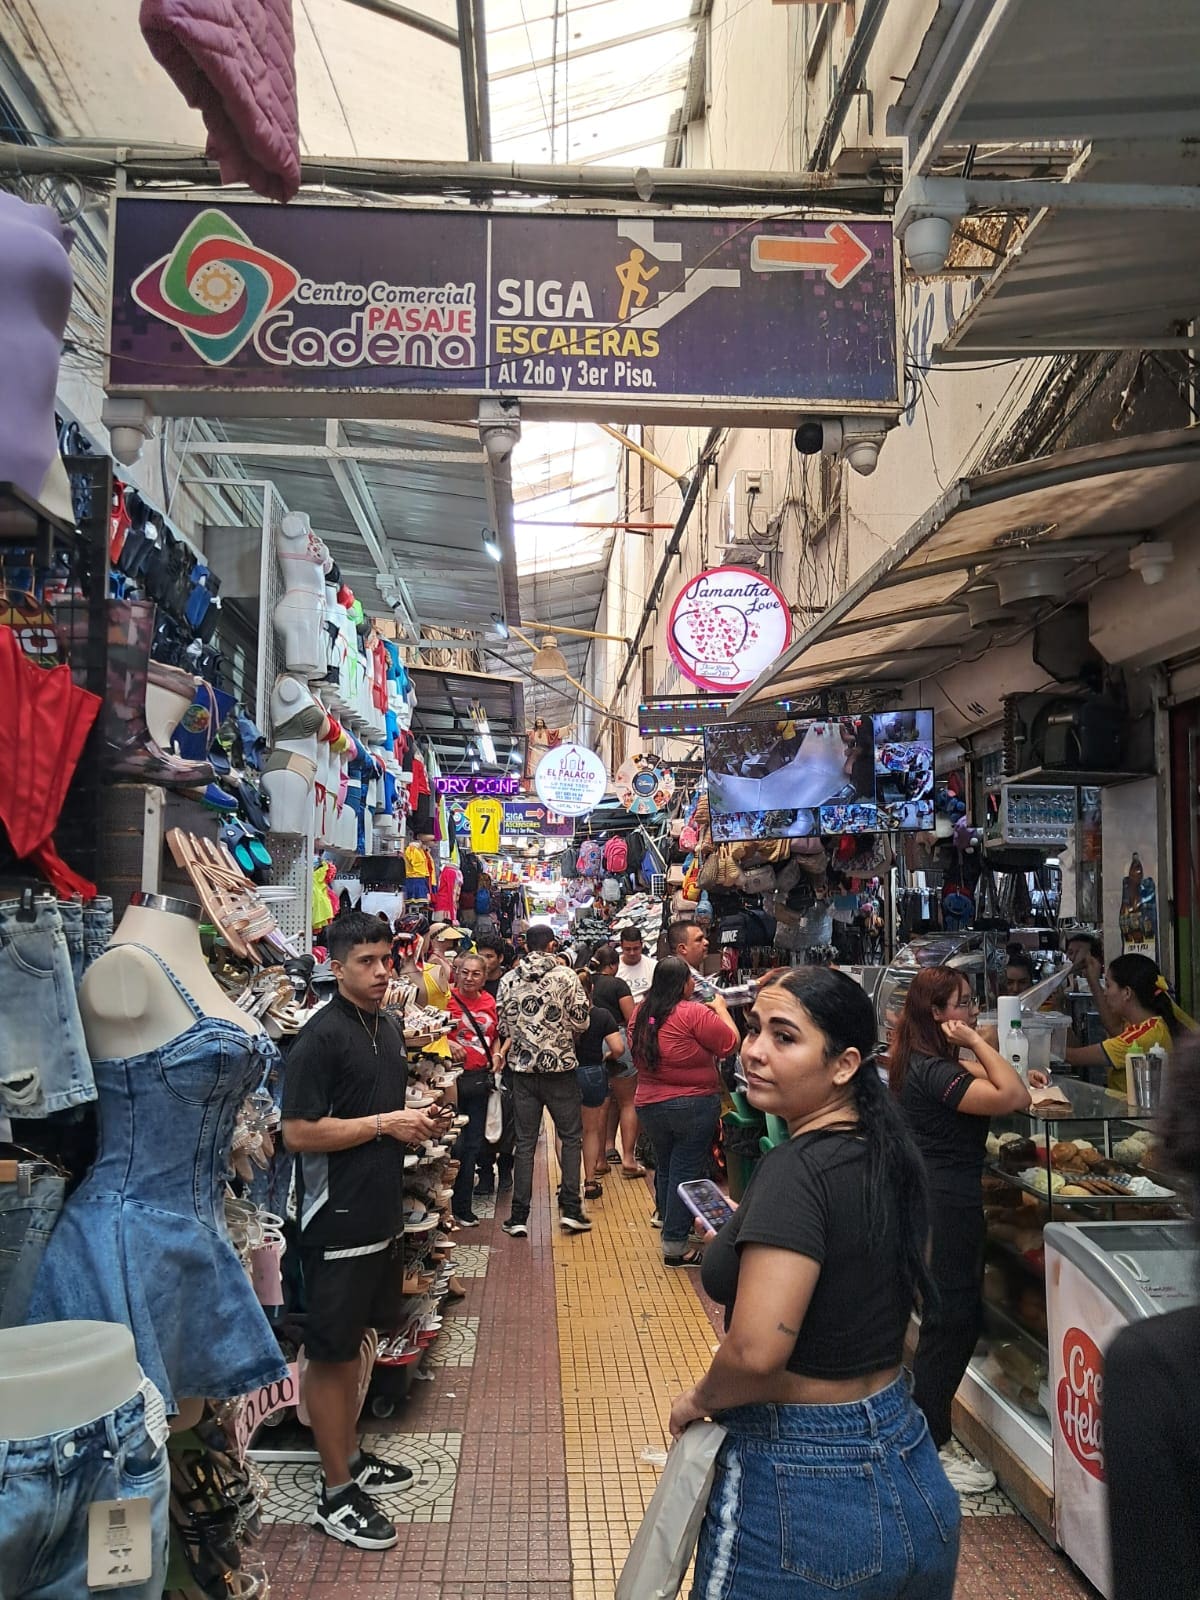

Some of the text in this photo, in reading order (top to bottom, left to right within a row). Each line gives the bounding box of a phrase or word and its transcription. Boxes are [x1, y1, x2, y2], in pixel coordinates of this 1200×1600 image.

[297, 282, 473, 306] Centro Comercial
[497, 279, 594, 319] SIGA
[368, 306, 472, 333] PASAJE
[257, 313, 474, 367] Cadena
[496, 326, 660, 358] ESCALERAS
[497, 360, 657, 391] Al 2do y 3er Piso.
[686, 577, 773, 600] Samantha
[744, 597, 782, 616] Love
[547, 769, 556, 777] EL
[559, 769, 595, 780] PALACIO
[480, 815, 491, 835] 7
[505, 812, 523, 821] SIGA
[720, 930, 739, 944] NIKE
[625, 977, 649, 987] OSS
[1069, 1344, 1104, 1406] Cre
